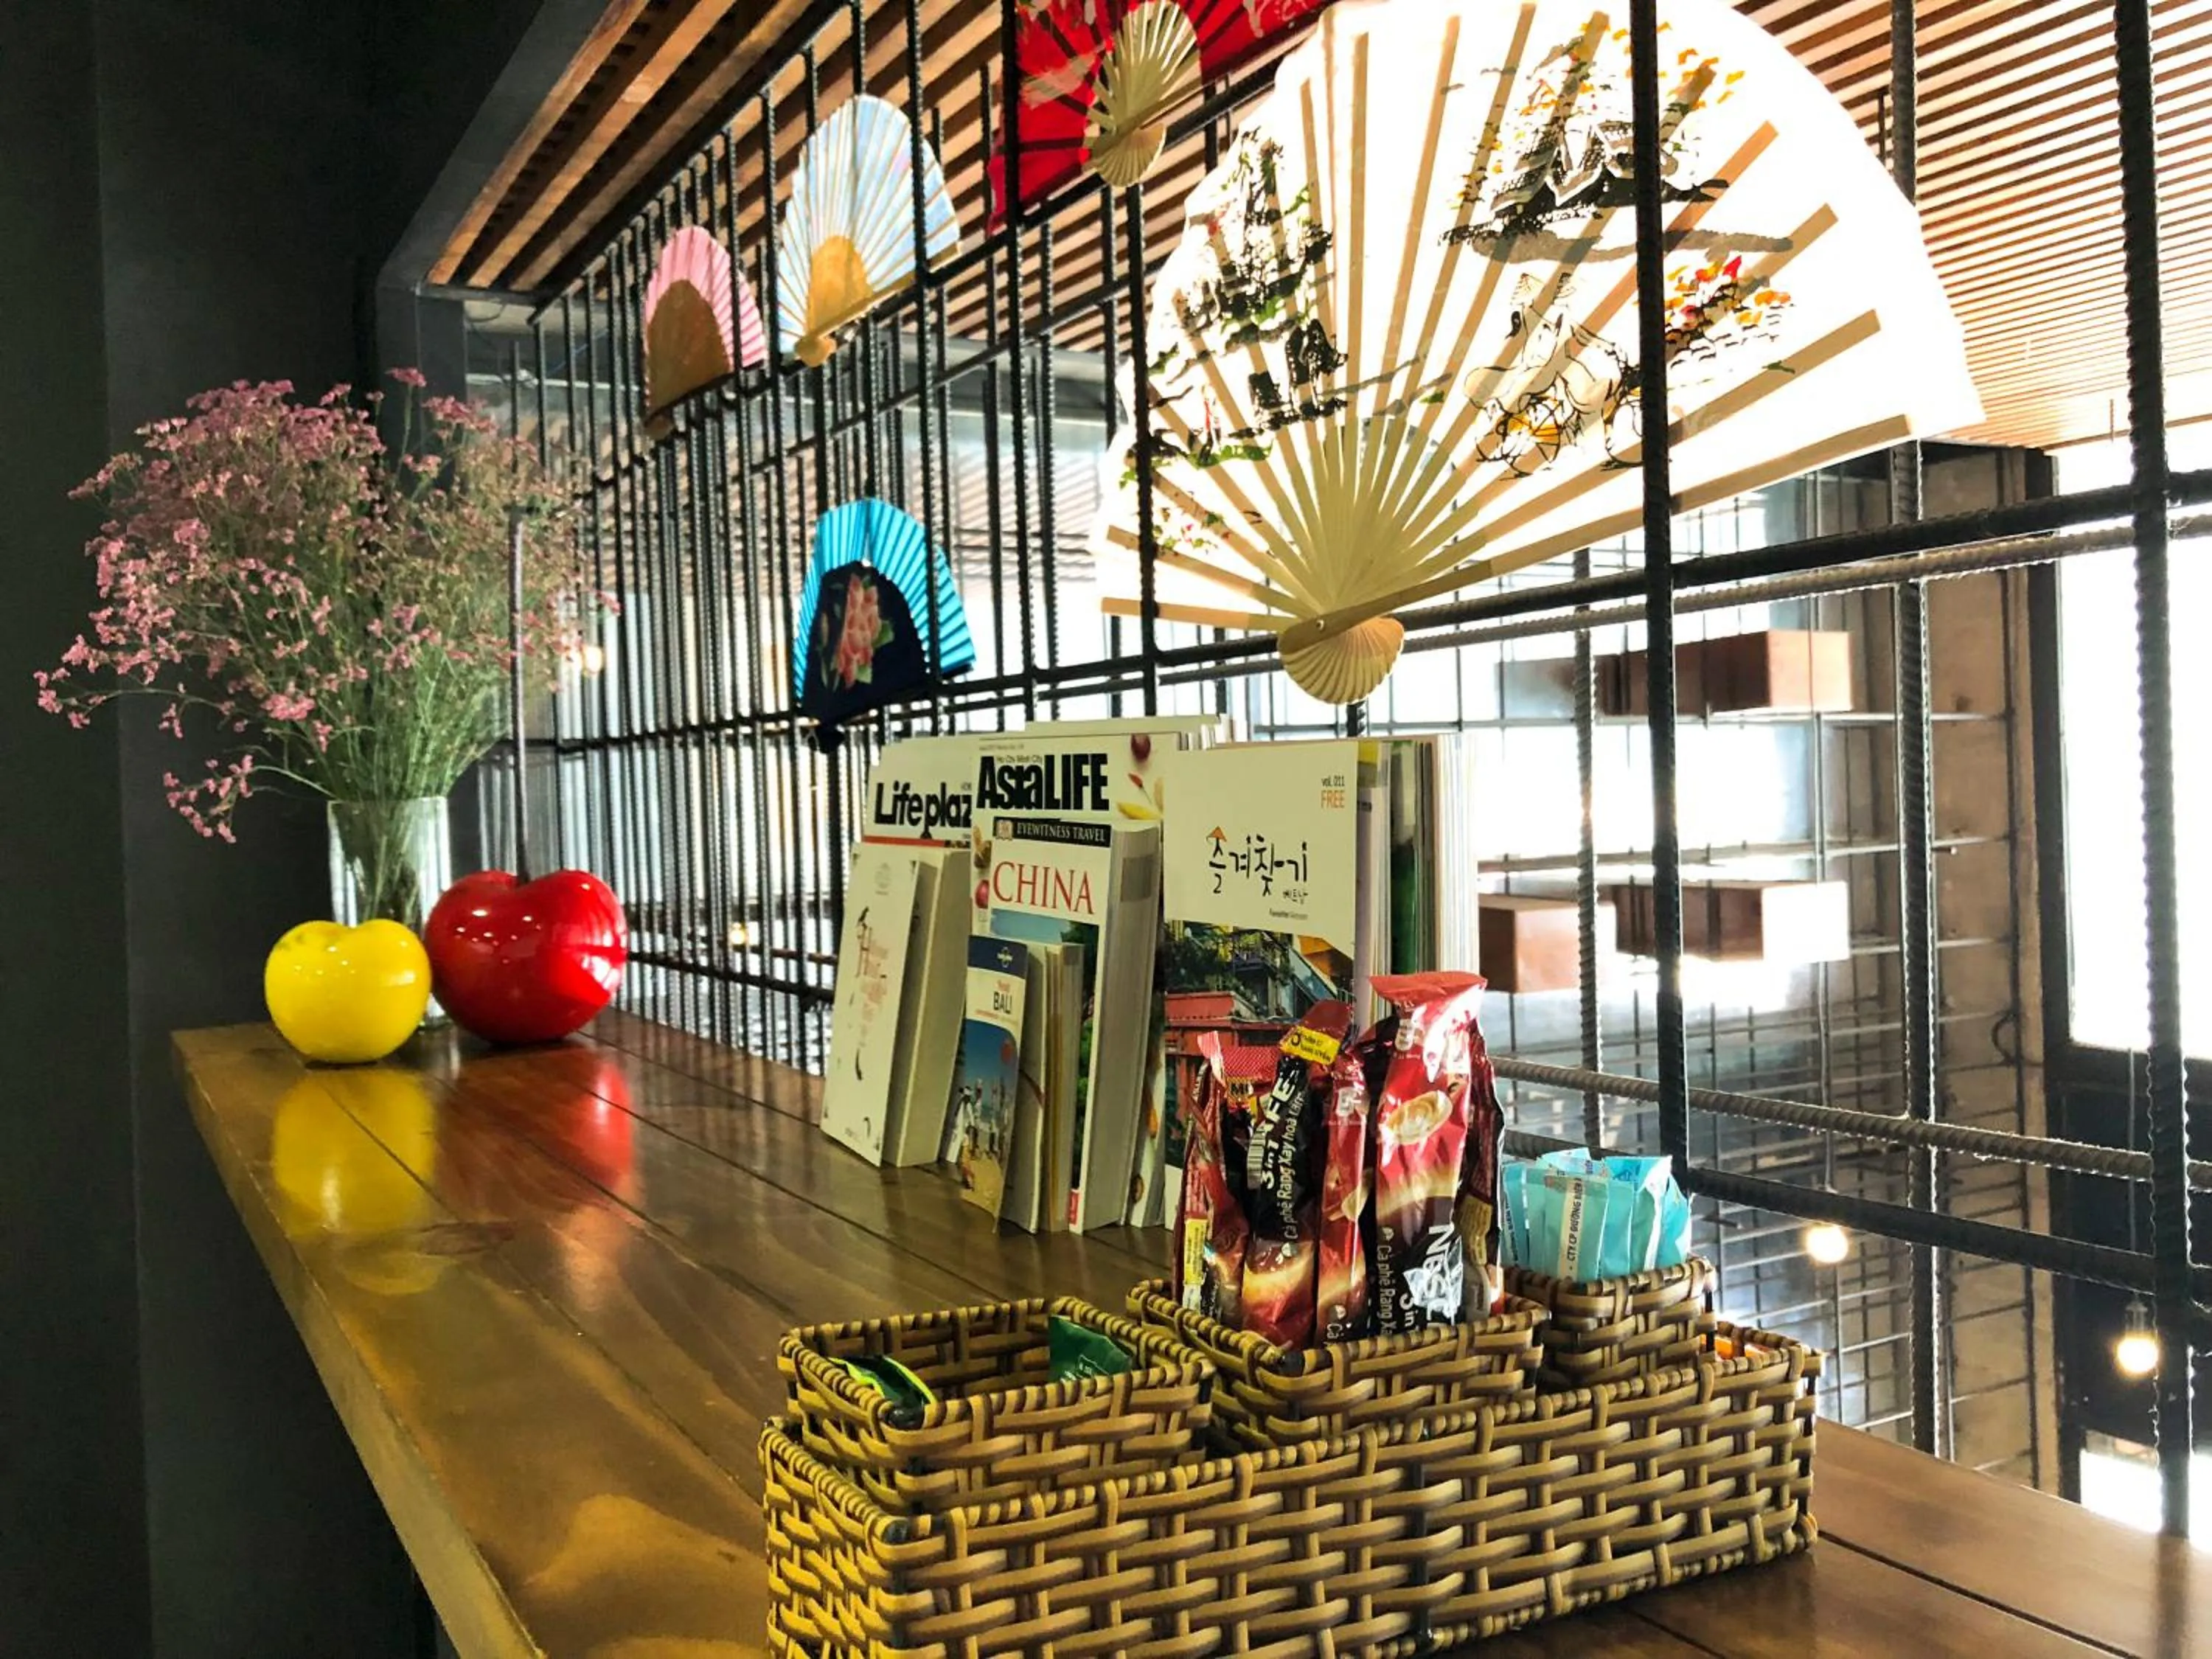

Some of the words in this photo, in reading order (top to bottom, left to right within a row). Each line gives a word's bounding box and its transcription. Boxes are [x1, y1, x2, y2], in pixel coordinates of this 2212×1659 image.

[1321, 789, 1346, 809] FREE
[1017, 821, 1070, 839] EYEWITNESS
[1073, 827, 1105, 842] TRAVEL
[993, 860, 1095, 915] CHINA
[1265, 1151, 1275, 1169] in
[1261, 1169, 1274, 1189] 3
[1377, 1288, 1396, 1319] Rang
